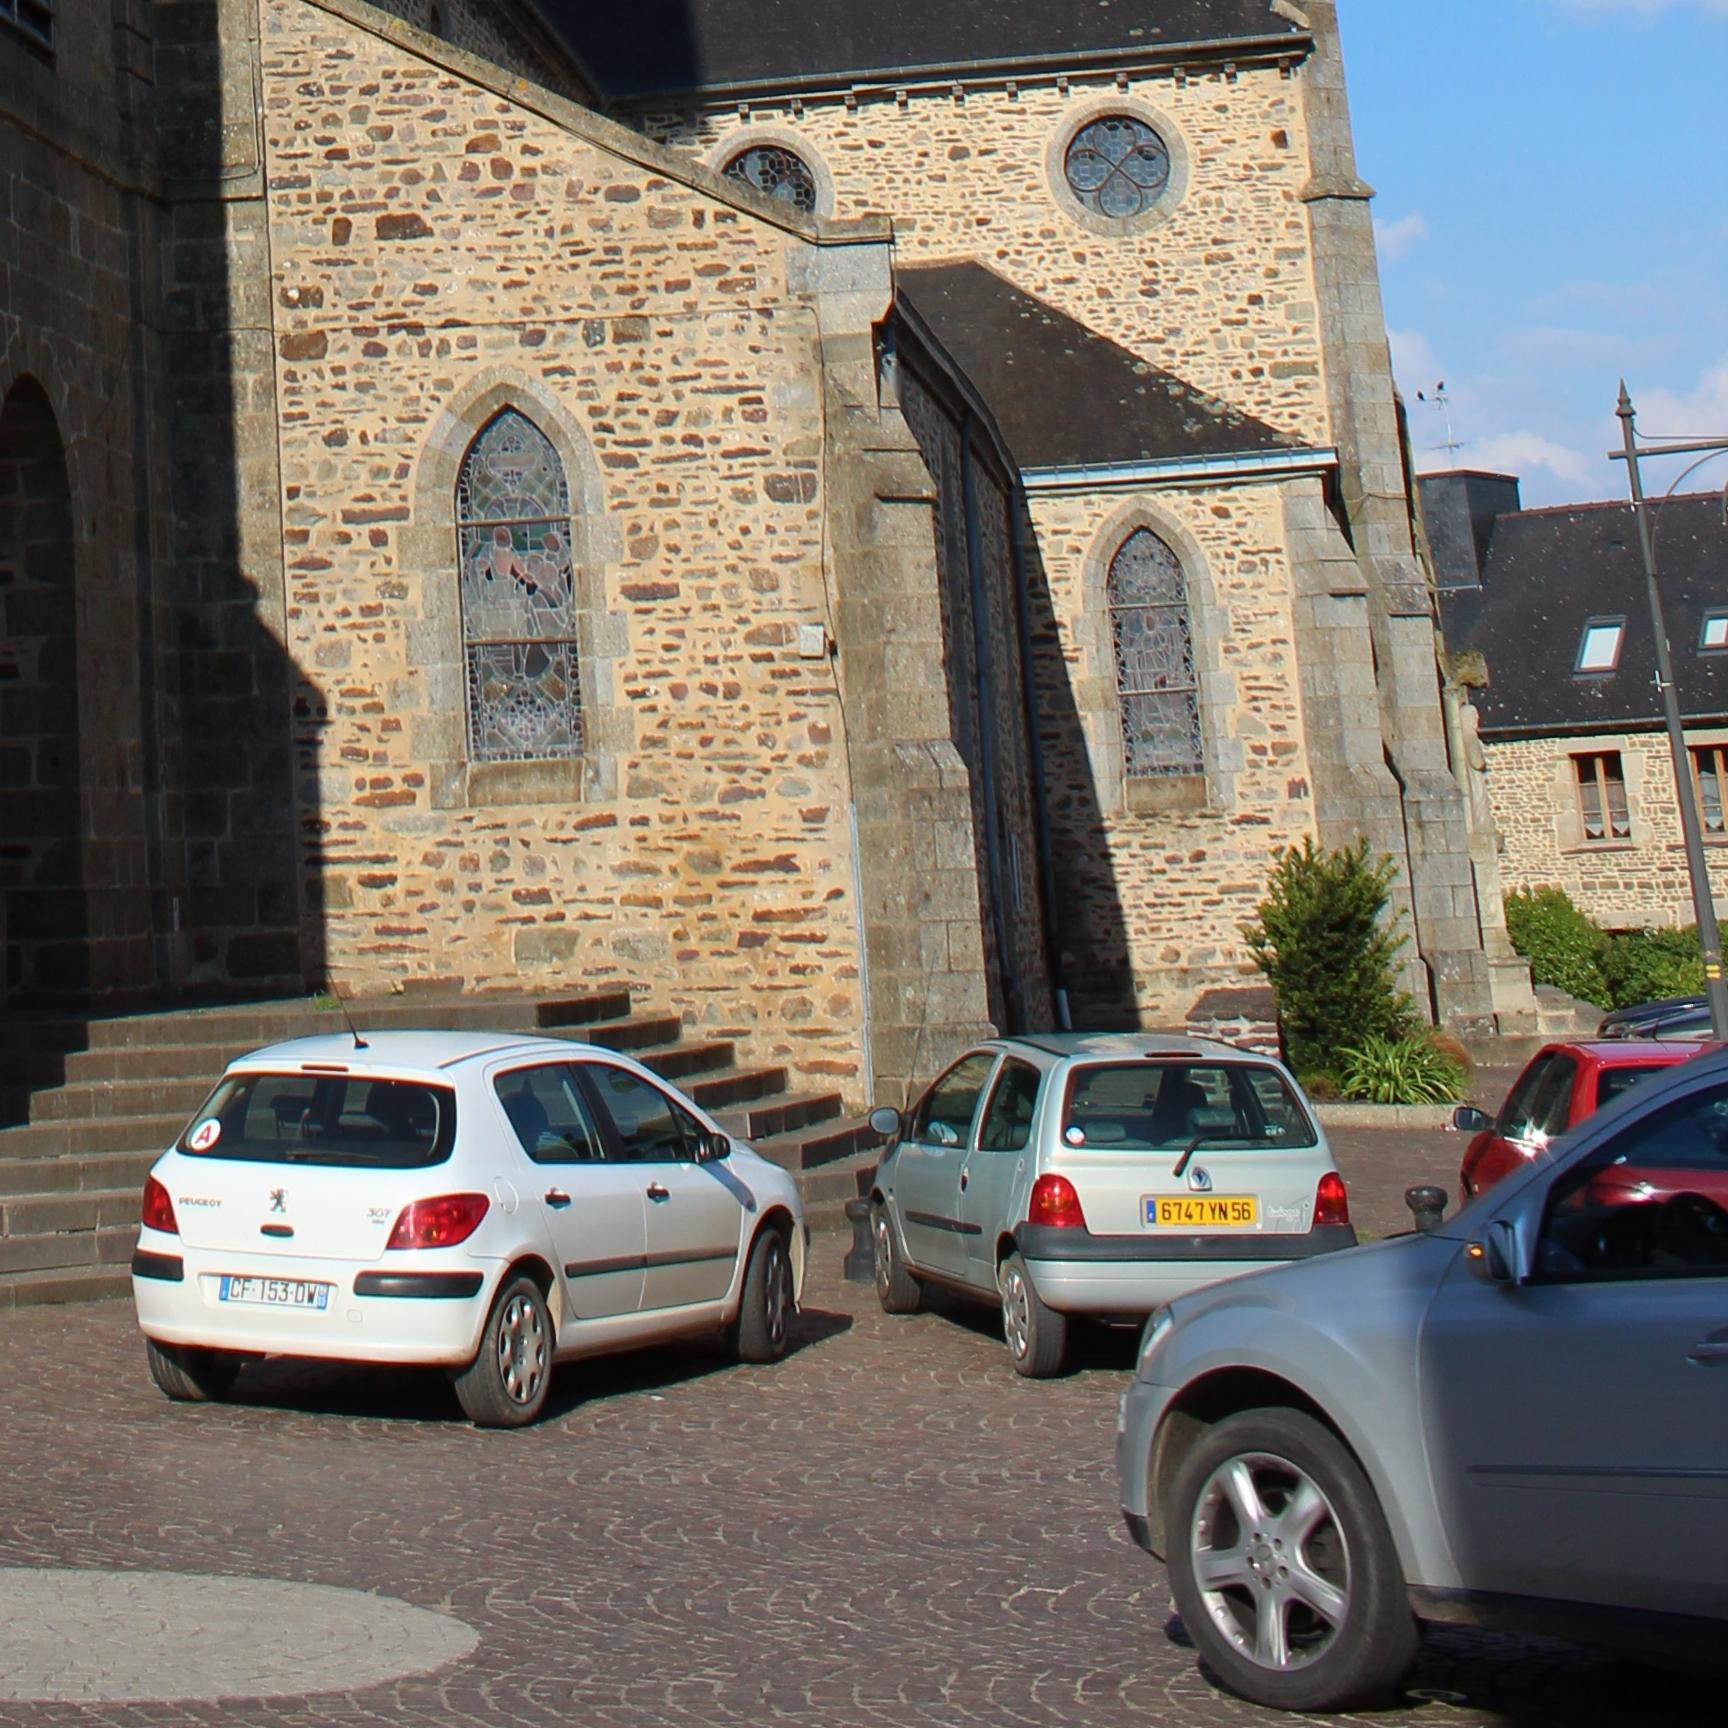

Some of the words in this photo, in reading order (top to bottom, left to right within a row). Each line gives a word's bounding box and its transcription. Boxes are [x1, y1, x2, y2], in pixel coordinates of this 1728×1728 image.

[194, 1124, 212, 1144] A
[179, 1197, 222, 1207] PEUGEOT
[1161, 1202, 1204, 1221] 6747
[1208, 1202, 1228, 1221] YN
[1231, 1202, 1251, 1221] 56
